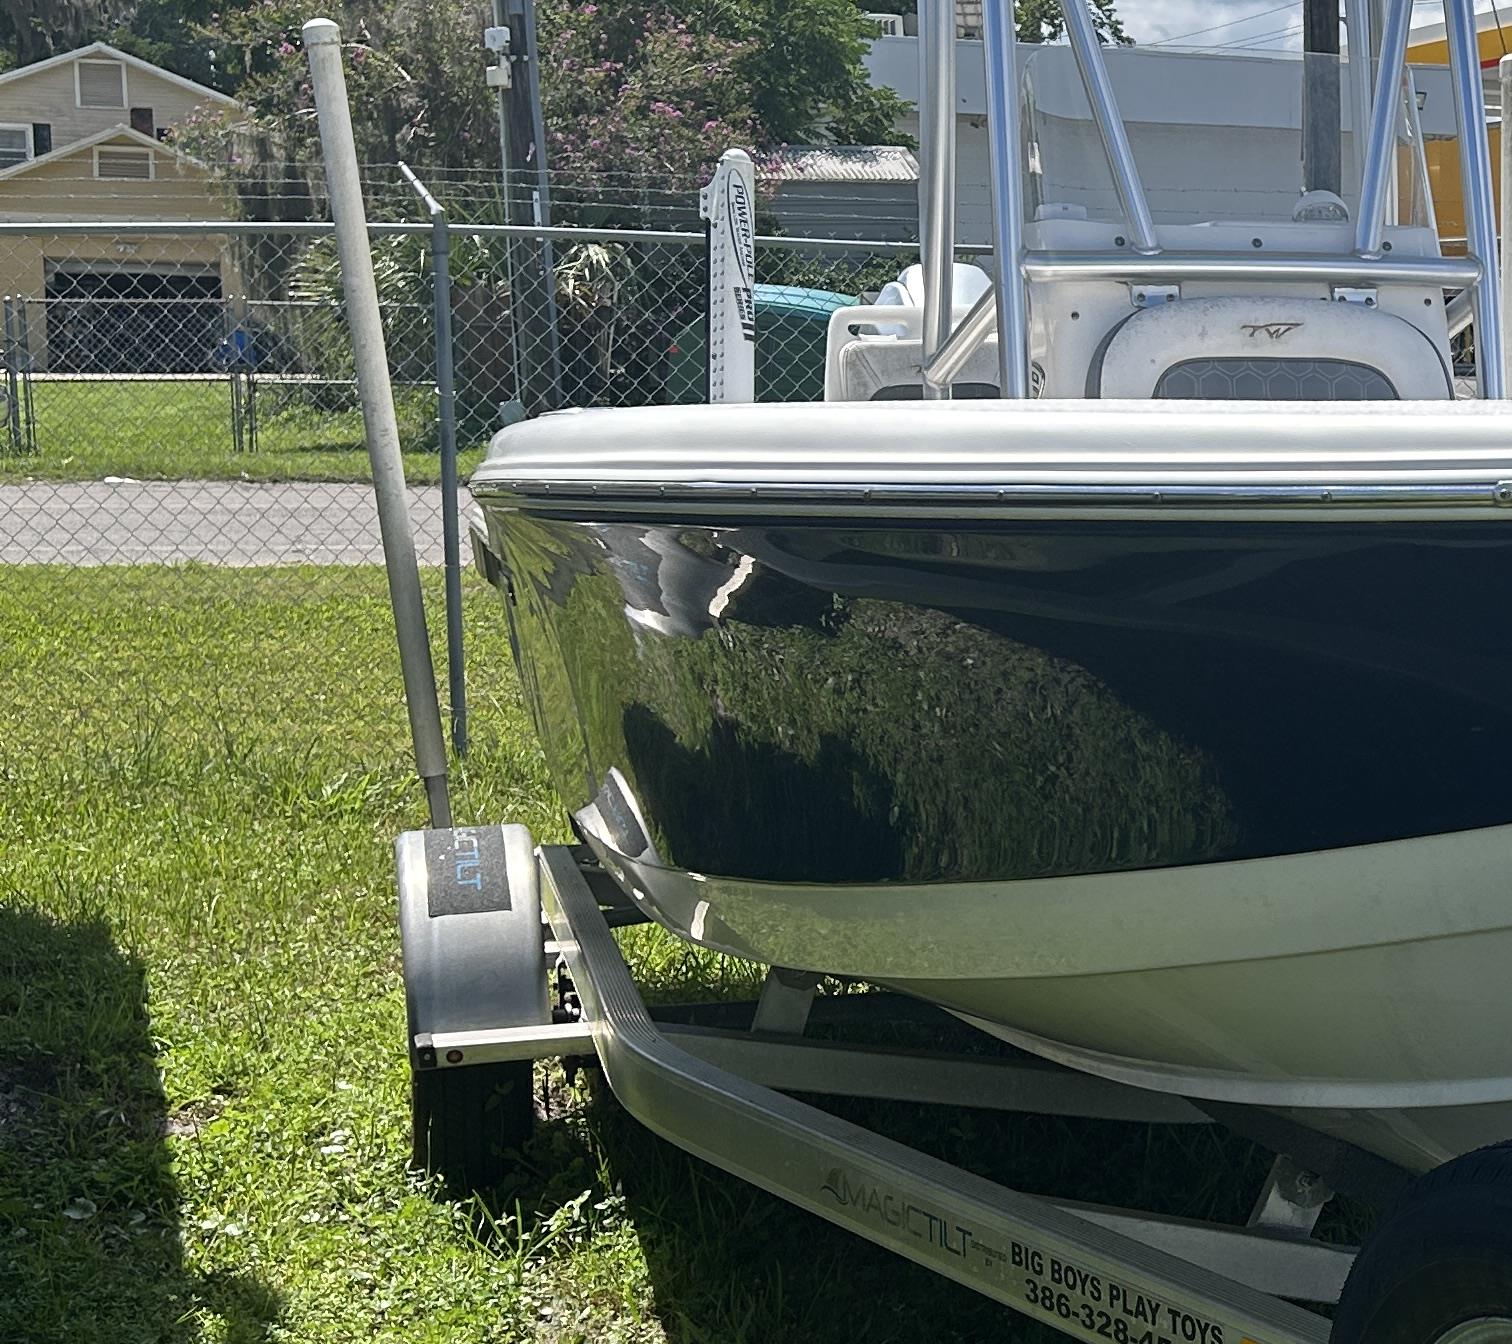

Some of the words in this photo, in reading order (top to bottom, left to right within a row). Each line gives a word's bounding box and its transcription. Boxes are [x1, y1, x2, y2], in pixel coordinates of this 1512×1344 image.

[1011, 1241, 1044, 1276] BIG
[1050, 1258, 1101, 1302] BOYS
[1109, 1283, 1161, 1327] PLAY
